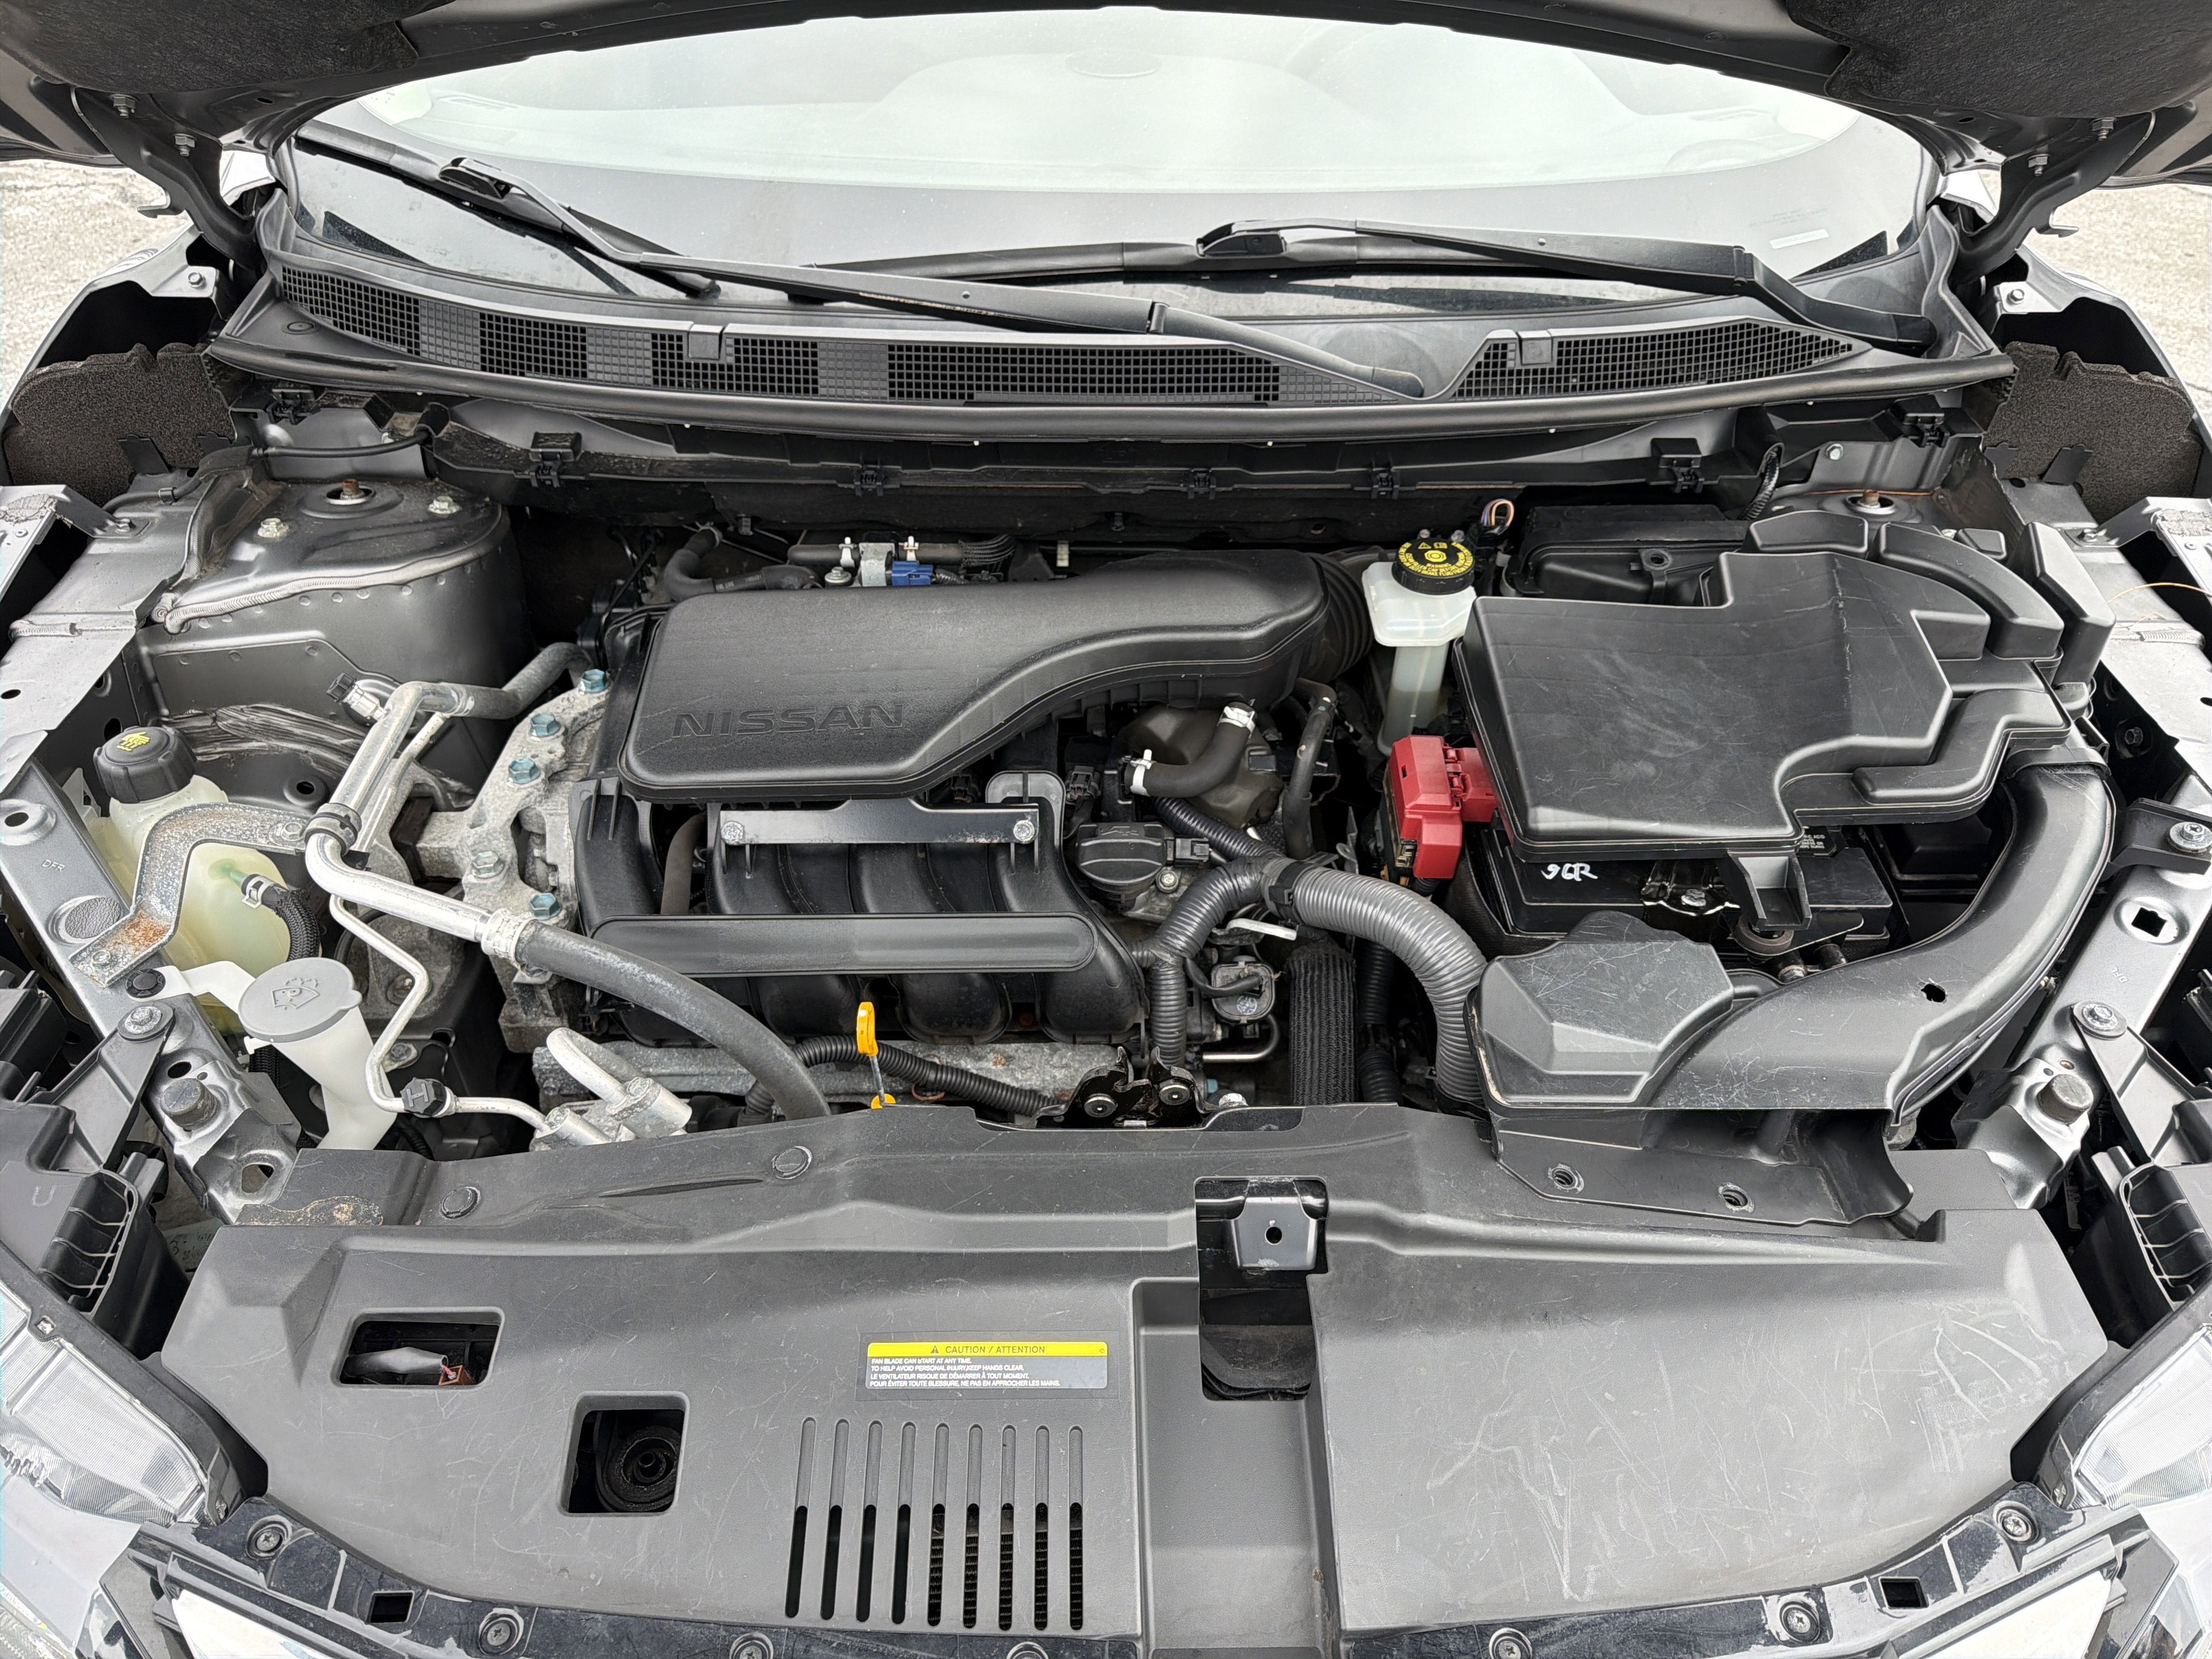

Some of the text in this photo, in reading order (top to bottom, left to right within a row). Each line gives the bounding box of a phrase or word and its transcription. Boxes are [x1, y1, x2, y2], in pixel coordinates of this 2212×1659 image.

[672, 704, 904, 738] NISSAN
[42, 859, 65, 873] DFR
[945, 1346, 986, 1354] CAUTION
